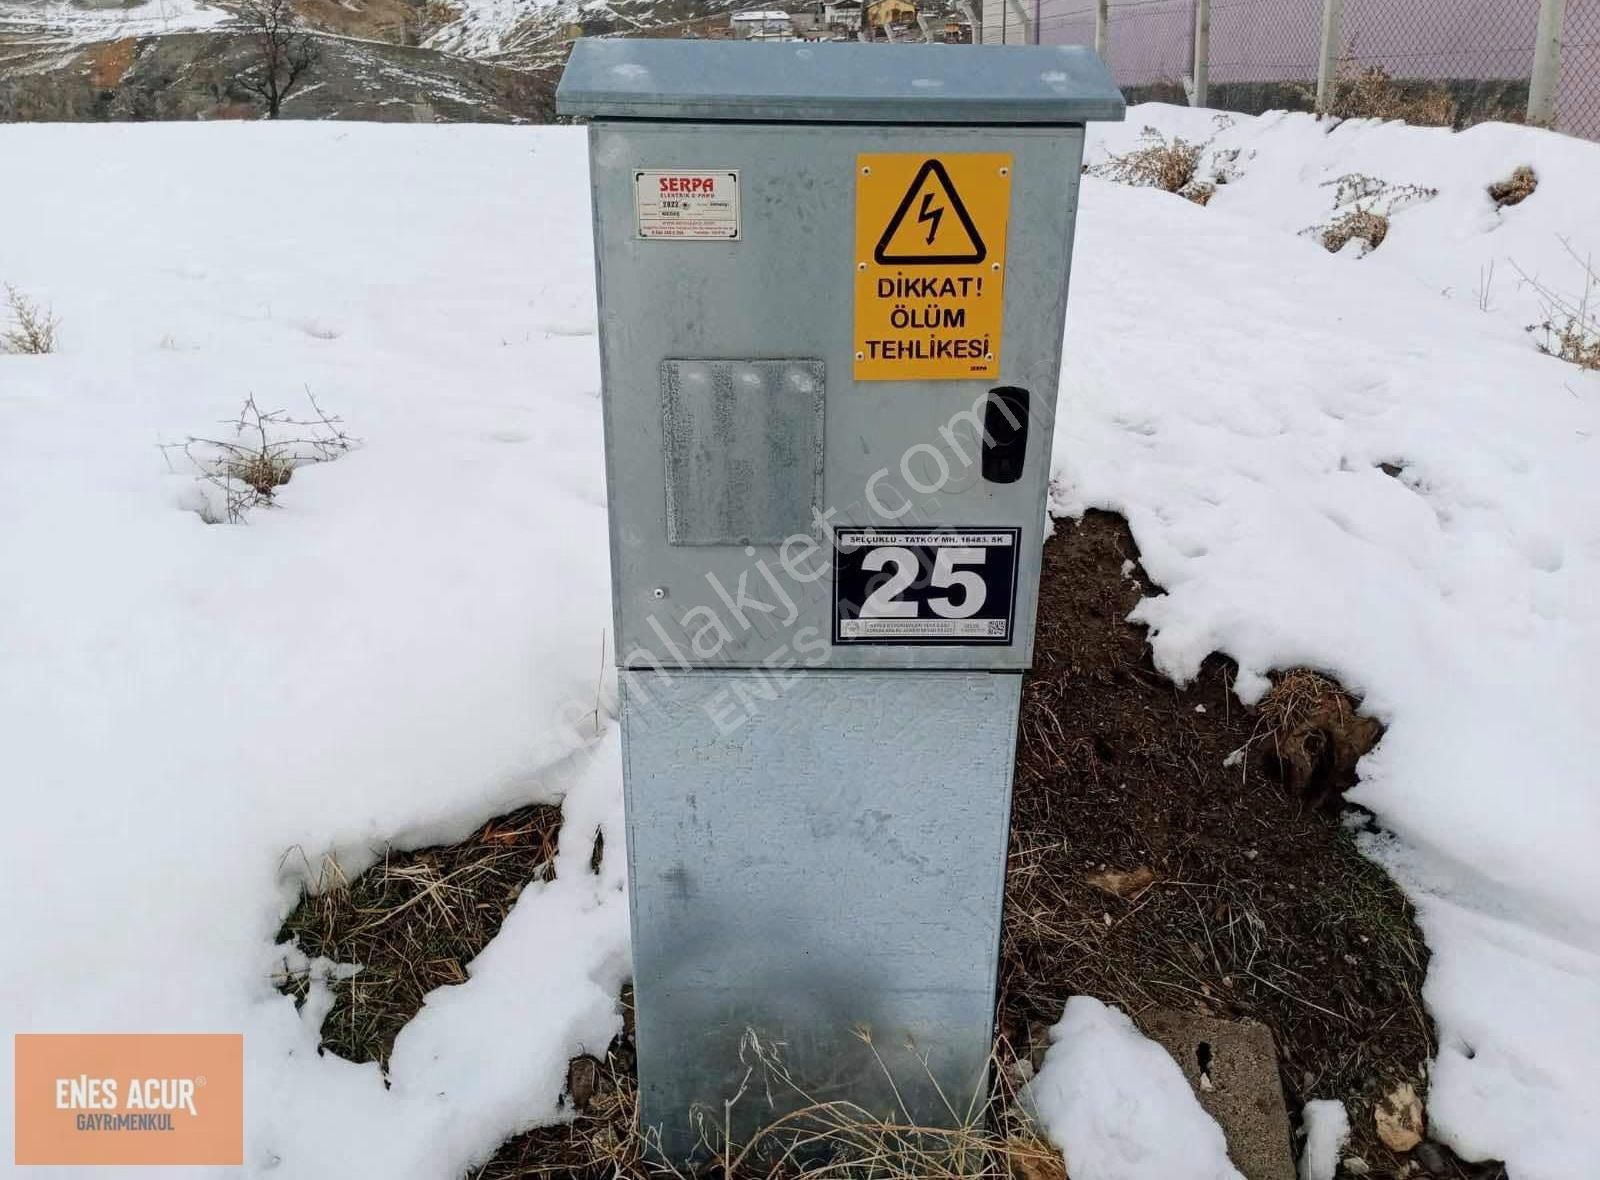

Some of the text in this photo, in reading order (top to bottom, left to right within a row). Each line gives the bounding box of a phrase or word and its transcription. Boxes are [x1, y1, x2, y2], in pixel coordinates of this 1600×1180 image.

[659, 177, 714, 192] SERPA
[878, 271, 982, 298] DİKKAT!
[890, 304, 965, 328] ÖLÜM
[865, 334, 989, 360] TEHLİKESİ
[850, 536, 897, 544] SELÇUKLU
[859, 546, 987, 618] 25
